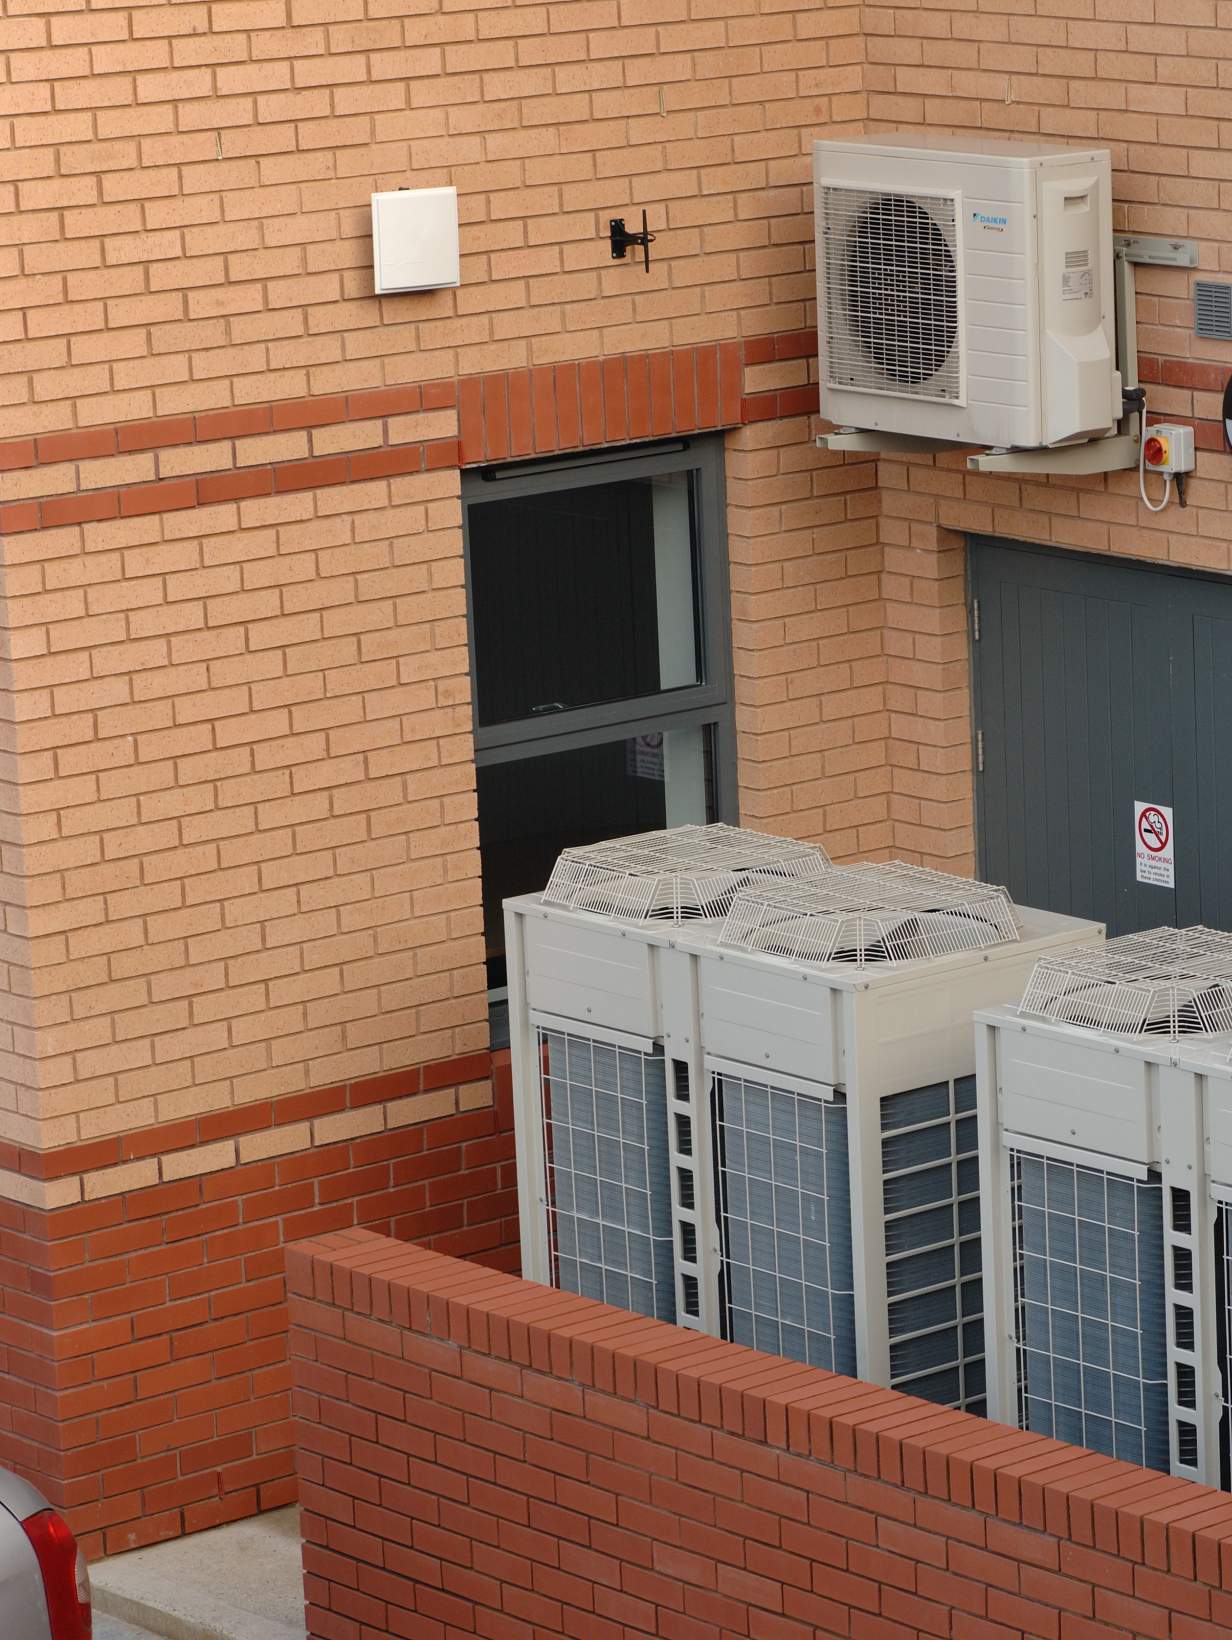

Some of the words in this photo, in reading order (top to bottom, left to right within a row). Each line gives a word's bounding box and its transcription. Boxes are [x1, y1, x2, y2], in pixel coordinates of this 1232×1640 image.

[980, 216, 1008, 225] DAIKIN
[1137, 852, 1145, 860] NO
[1147, 854, 1172, 865] SMOKING
